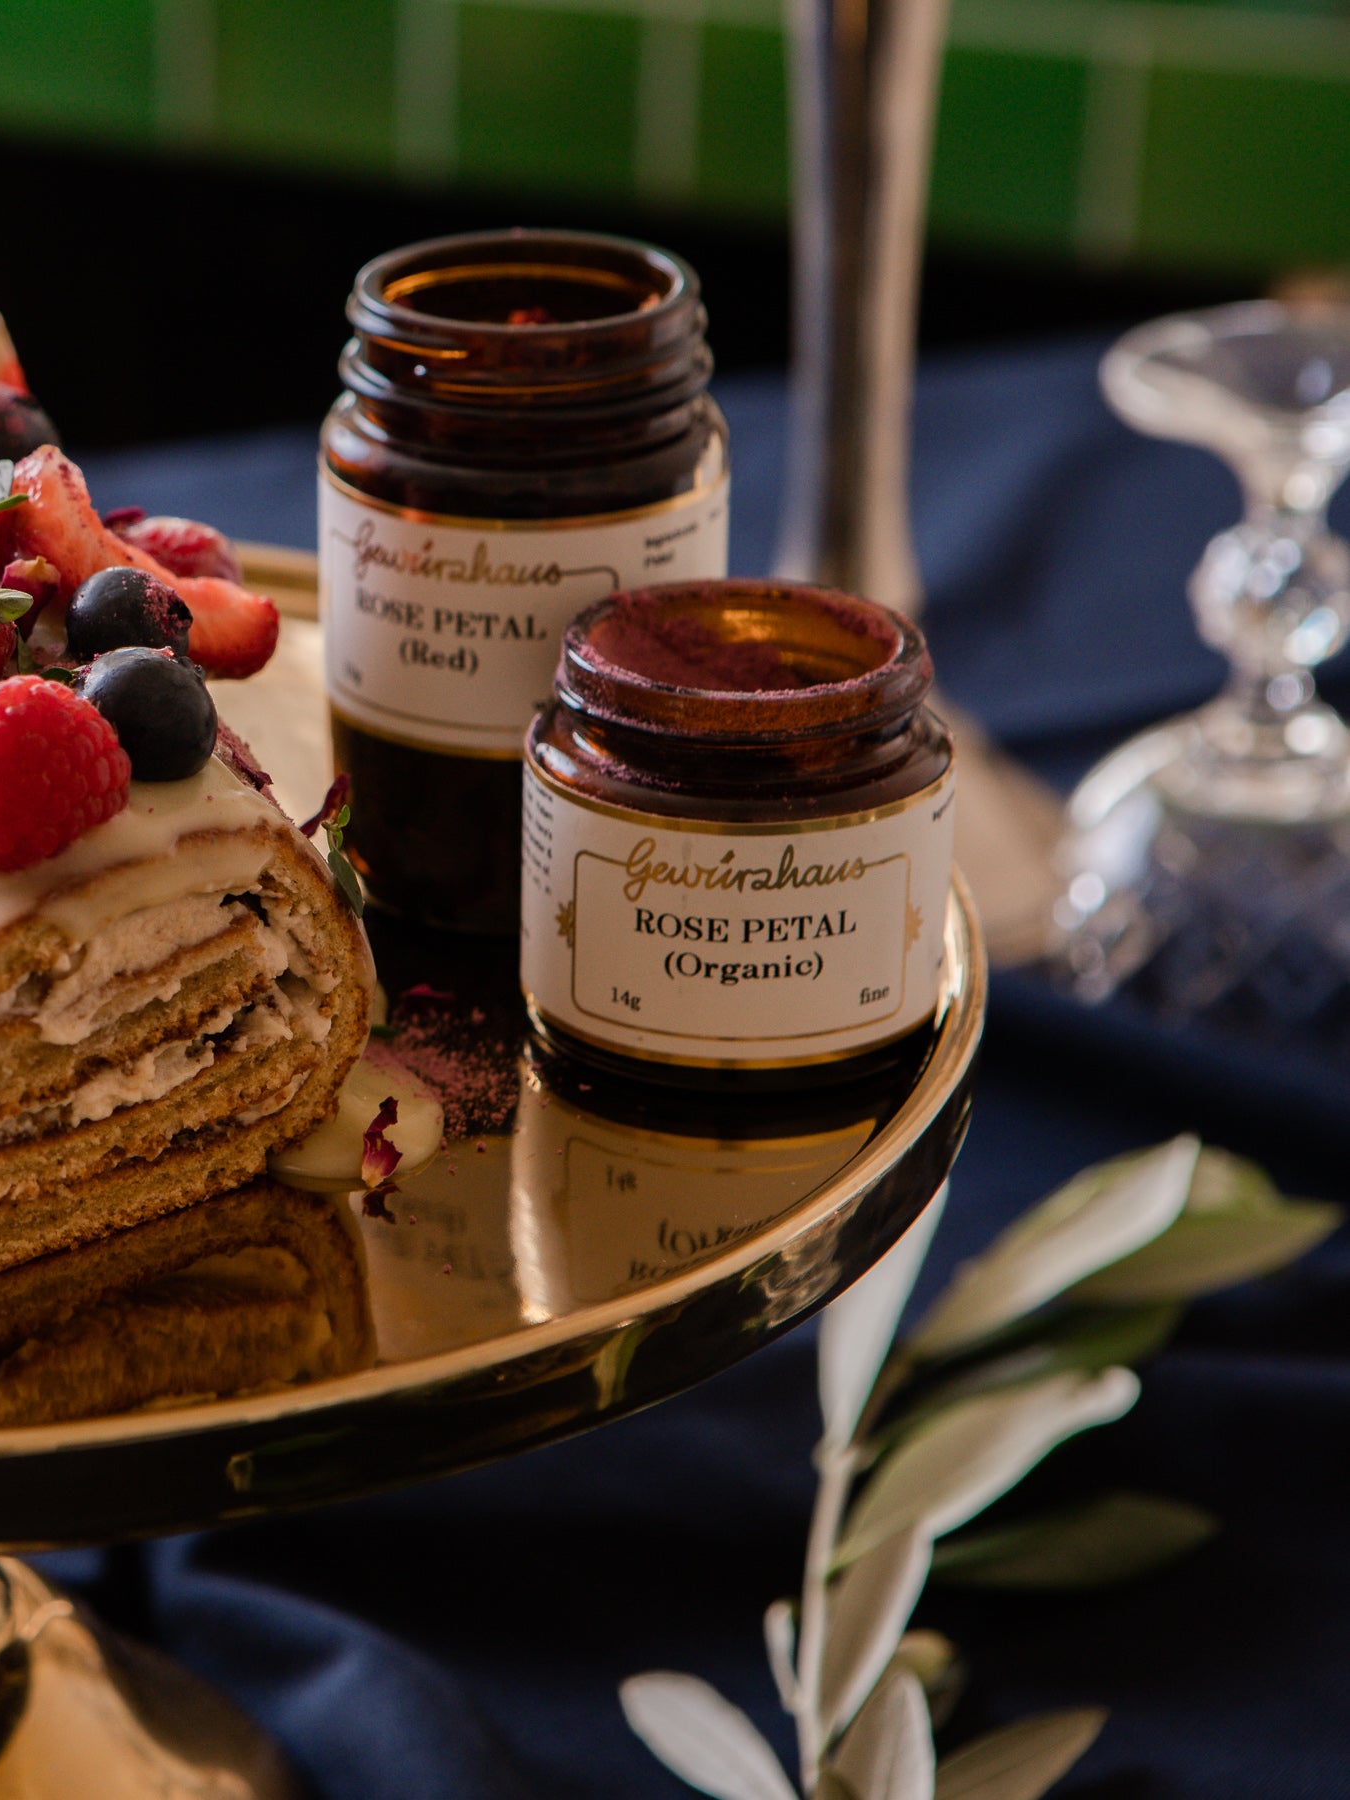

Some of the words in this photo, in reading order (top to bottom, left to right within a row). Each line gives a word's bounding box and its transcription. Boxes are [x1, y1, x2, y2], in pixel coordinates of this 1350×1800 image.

[356, 586, 425, 630] ROSE
[433, 606, 548, 640] PETAL
[399, 636, 479, 676] (Red)
[634, 907, 730, 943] ROSE
[740, 909, 857, 944] PETAL
[663, 950, 824, 986] (Organic)
[611, 986, 642, 1011] 14g
[858, 983, 891, 1006] fine
